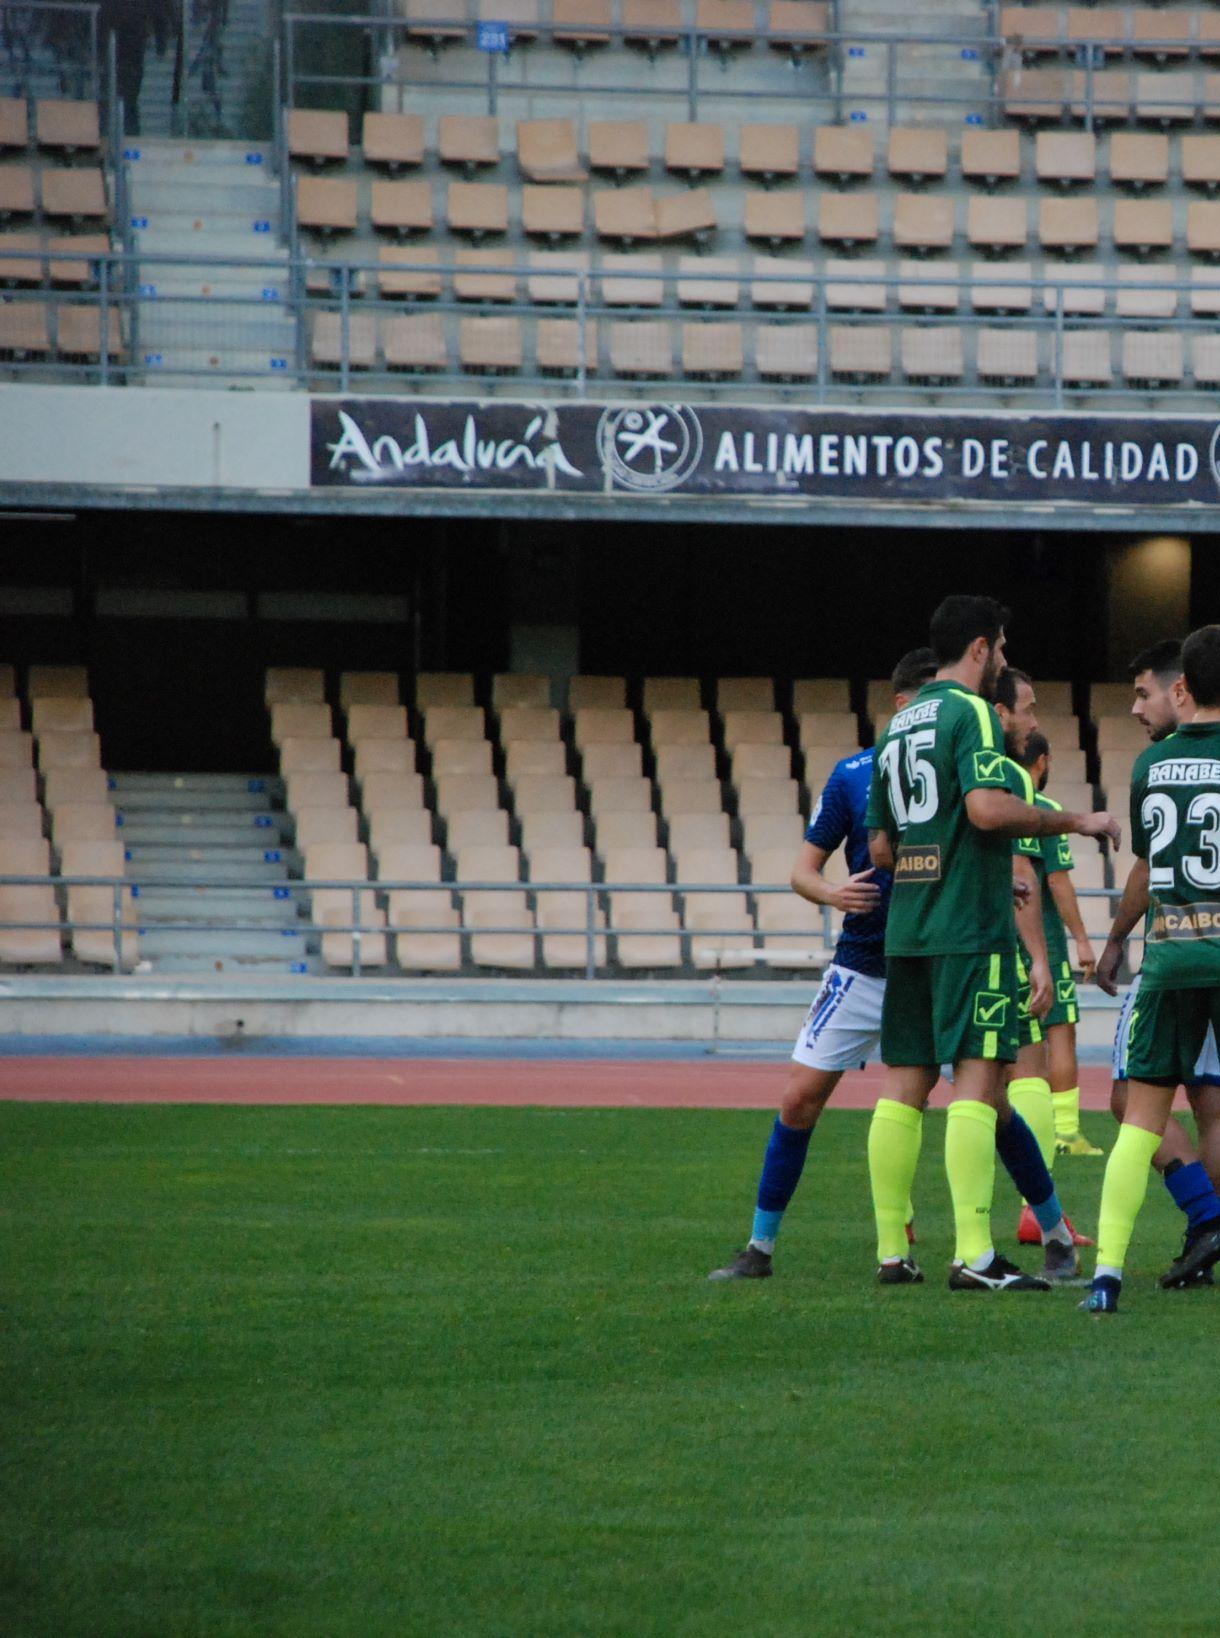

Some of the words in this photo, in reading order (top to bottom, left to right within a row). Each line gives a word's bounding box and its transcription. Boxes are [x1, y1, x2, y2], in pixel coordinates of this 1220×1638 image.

[326, 410, 584, 479] Andalucía
[715, 431, 943, 477] ALIMENTOS
[962, 439, 1009, 477] DE
[1027, 440, 1199, 481] CALIDAD
[878, 729, 939, 831] 15
